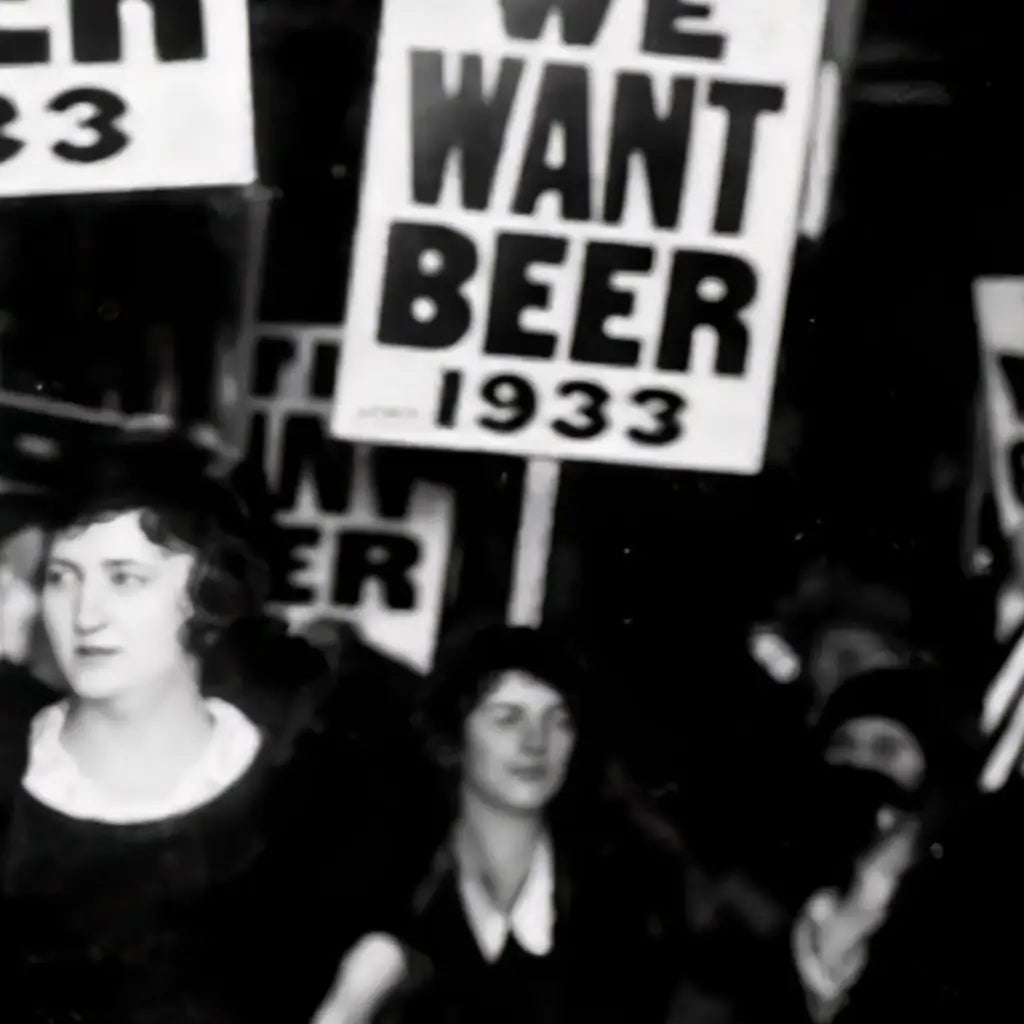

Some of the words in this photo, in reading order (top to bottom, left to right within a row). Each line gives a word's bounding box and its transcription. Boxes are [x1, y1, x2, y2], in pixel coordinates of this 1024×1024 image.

[0, 87, 129, 164] 3
[410, 50, 786, 236] WANT
[376, 221, 758, 378] BEER
[435, 369, 688, 446] 1933
[256, 527, 422, 612] ER
